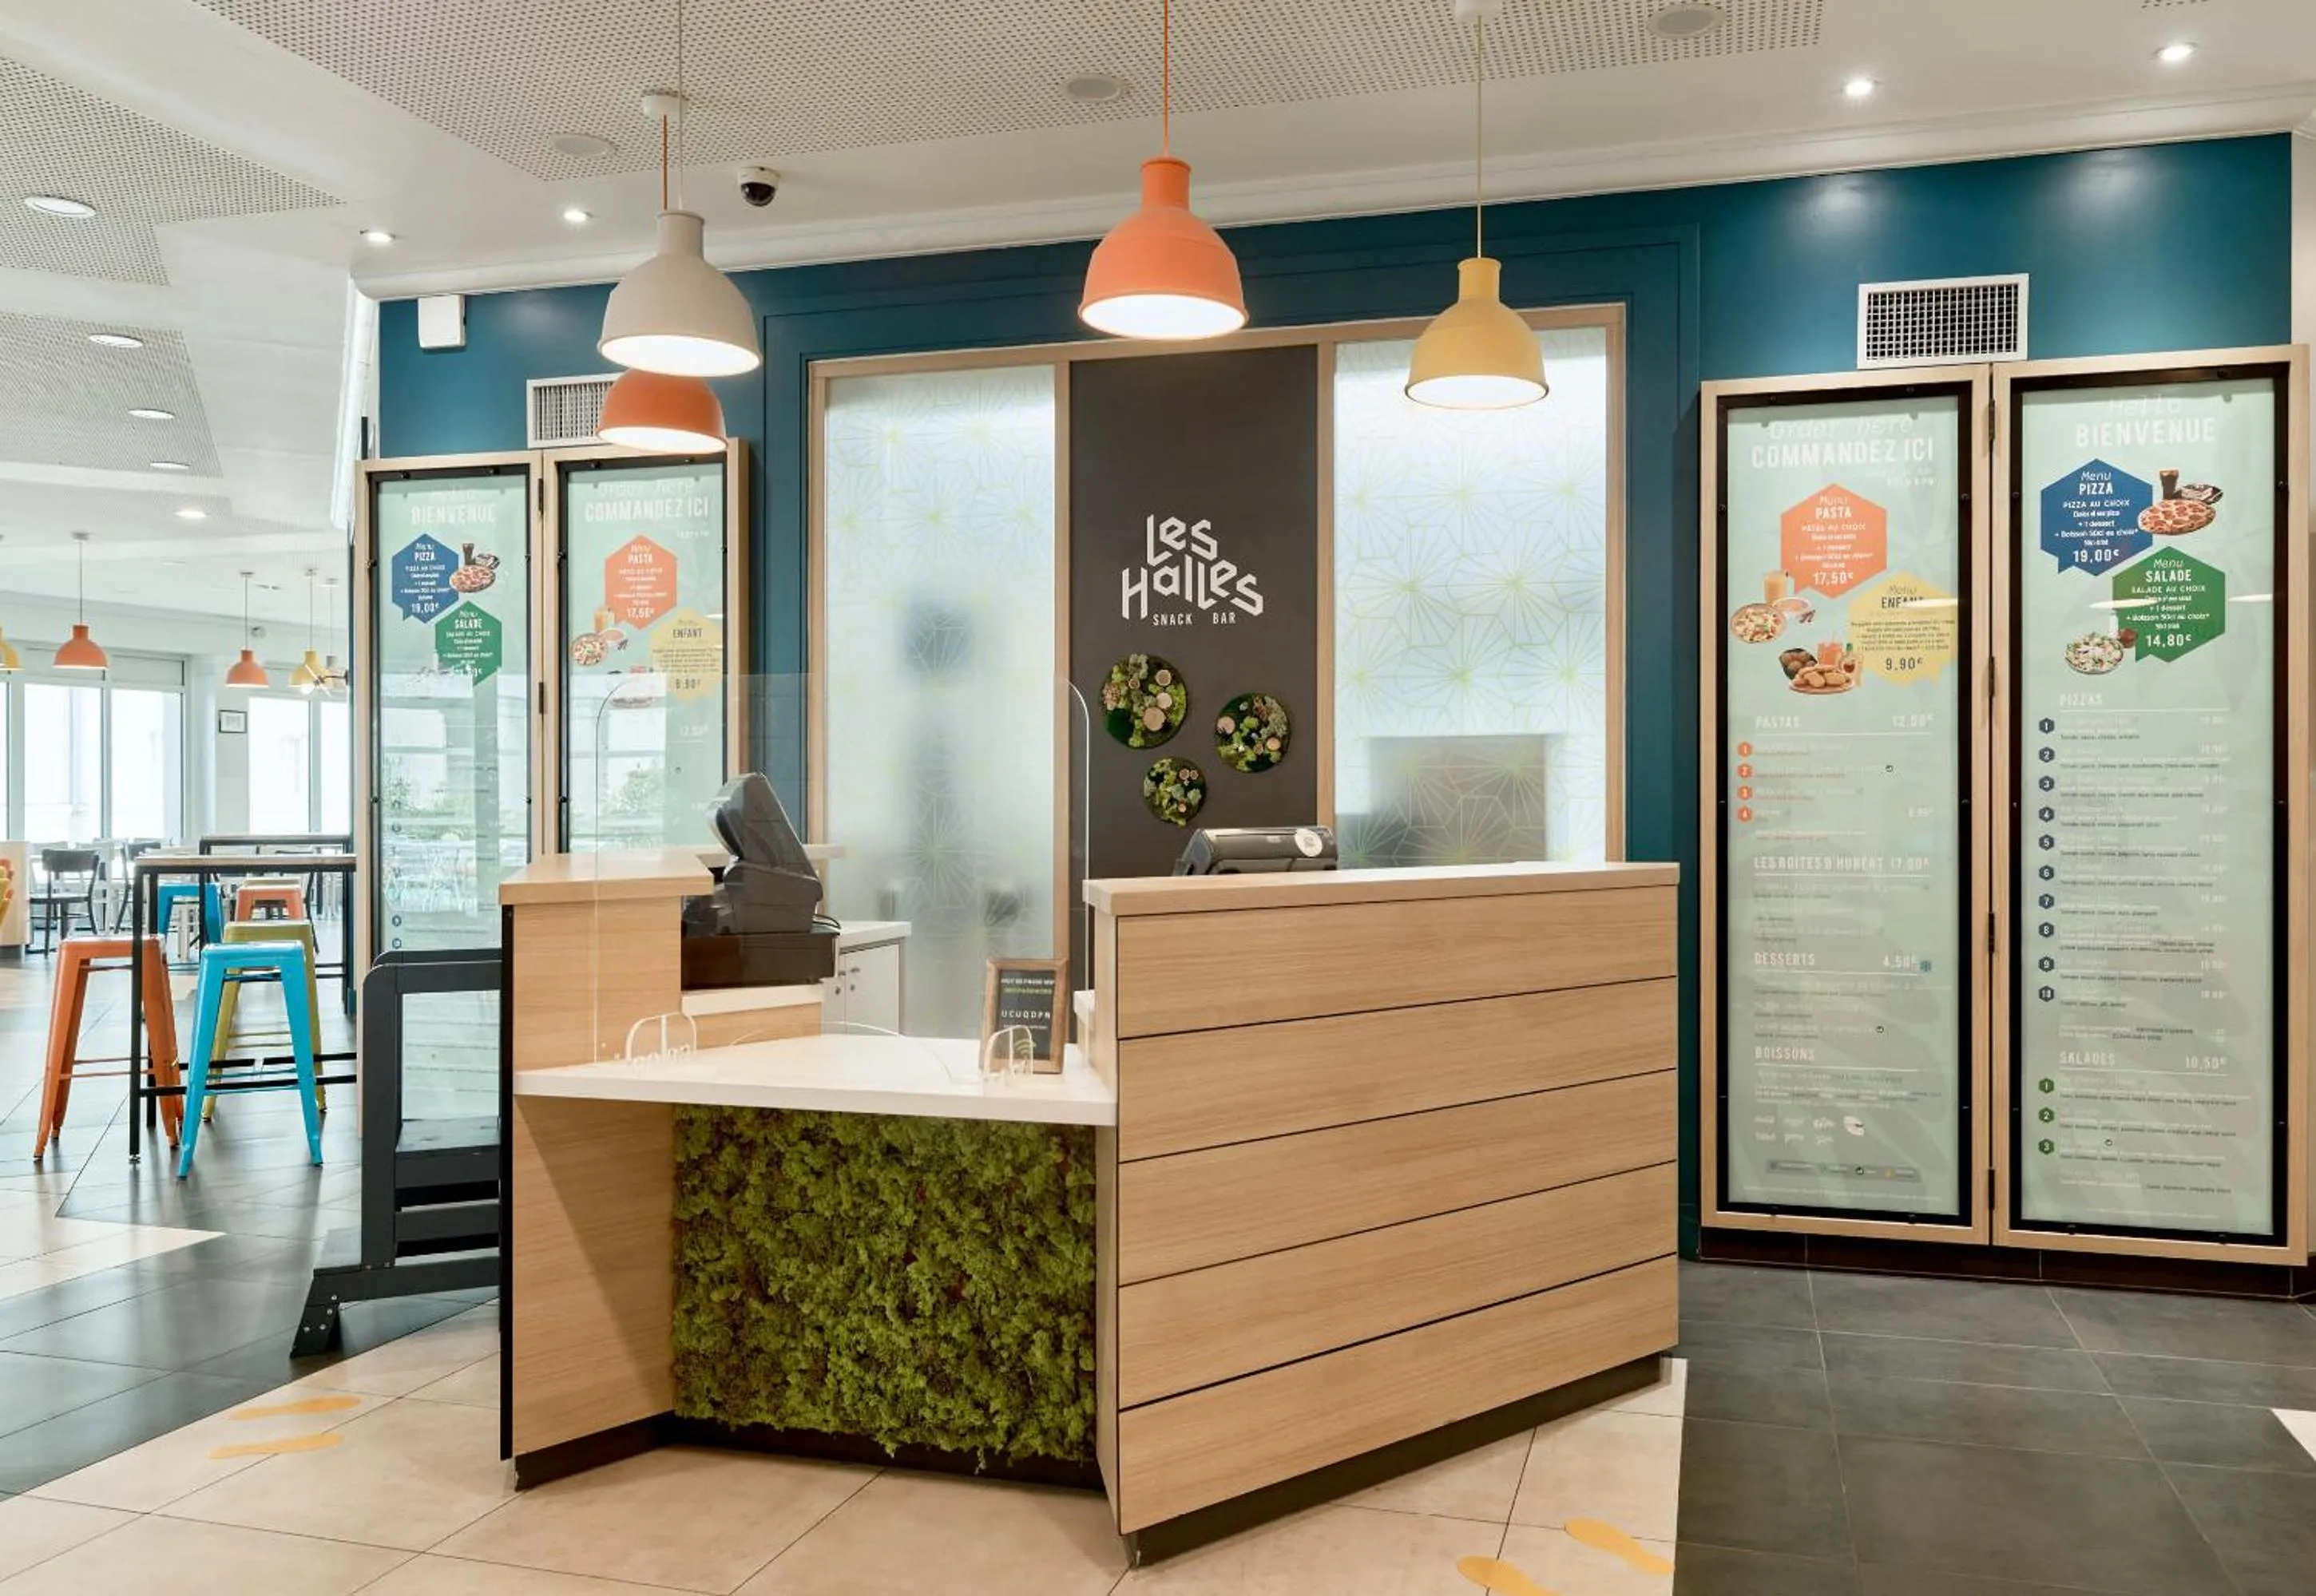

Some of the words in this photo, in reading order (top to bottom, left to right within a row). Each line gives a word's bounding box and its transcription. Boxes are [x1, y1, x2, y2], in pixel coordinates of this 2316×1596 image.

[2076, 417, 2217, 448] BIENVENUE
[1751, 438, 1898, 469] COMMANDEZ
[1904, 436, 1933, 463] ICI
[2080, 471, 2111, 481] Menu
[2079, 482, 2113, 495] PIZZA
[411, 504, 496, 525] BIENVENUE
[585, 498, 683, 523] COMMANDEZ
[688, 496, 708, 519] ICI
[1815, 506, 1852, 520] PASTA
[1147, 514, 1218, 567] Les
[2153, 559, 2183, 568] Menu
[2145, 568, 2191, 583] SALADE
[1153, 613, 1193, 627] SNACK
[1212, 612, 1236, 624] BAR
[672, 628, 703, 639] ENFANT
[2060, 691, 2103, 707] PIZZAS
[1755, 715, 1800, 729] PASTAS
[1755, 952, 1815, 966] DESSERTS
[1755, 1046, 1815, 1062] BOISSONS
[2060, 1051, 2116, 1067] SALADES
